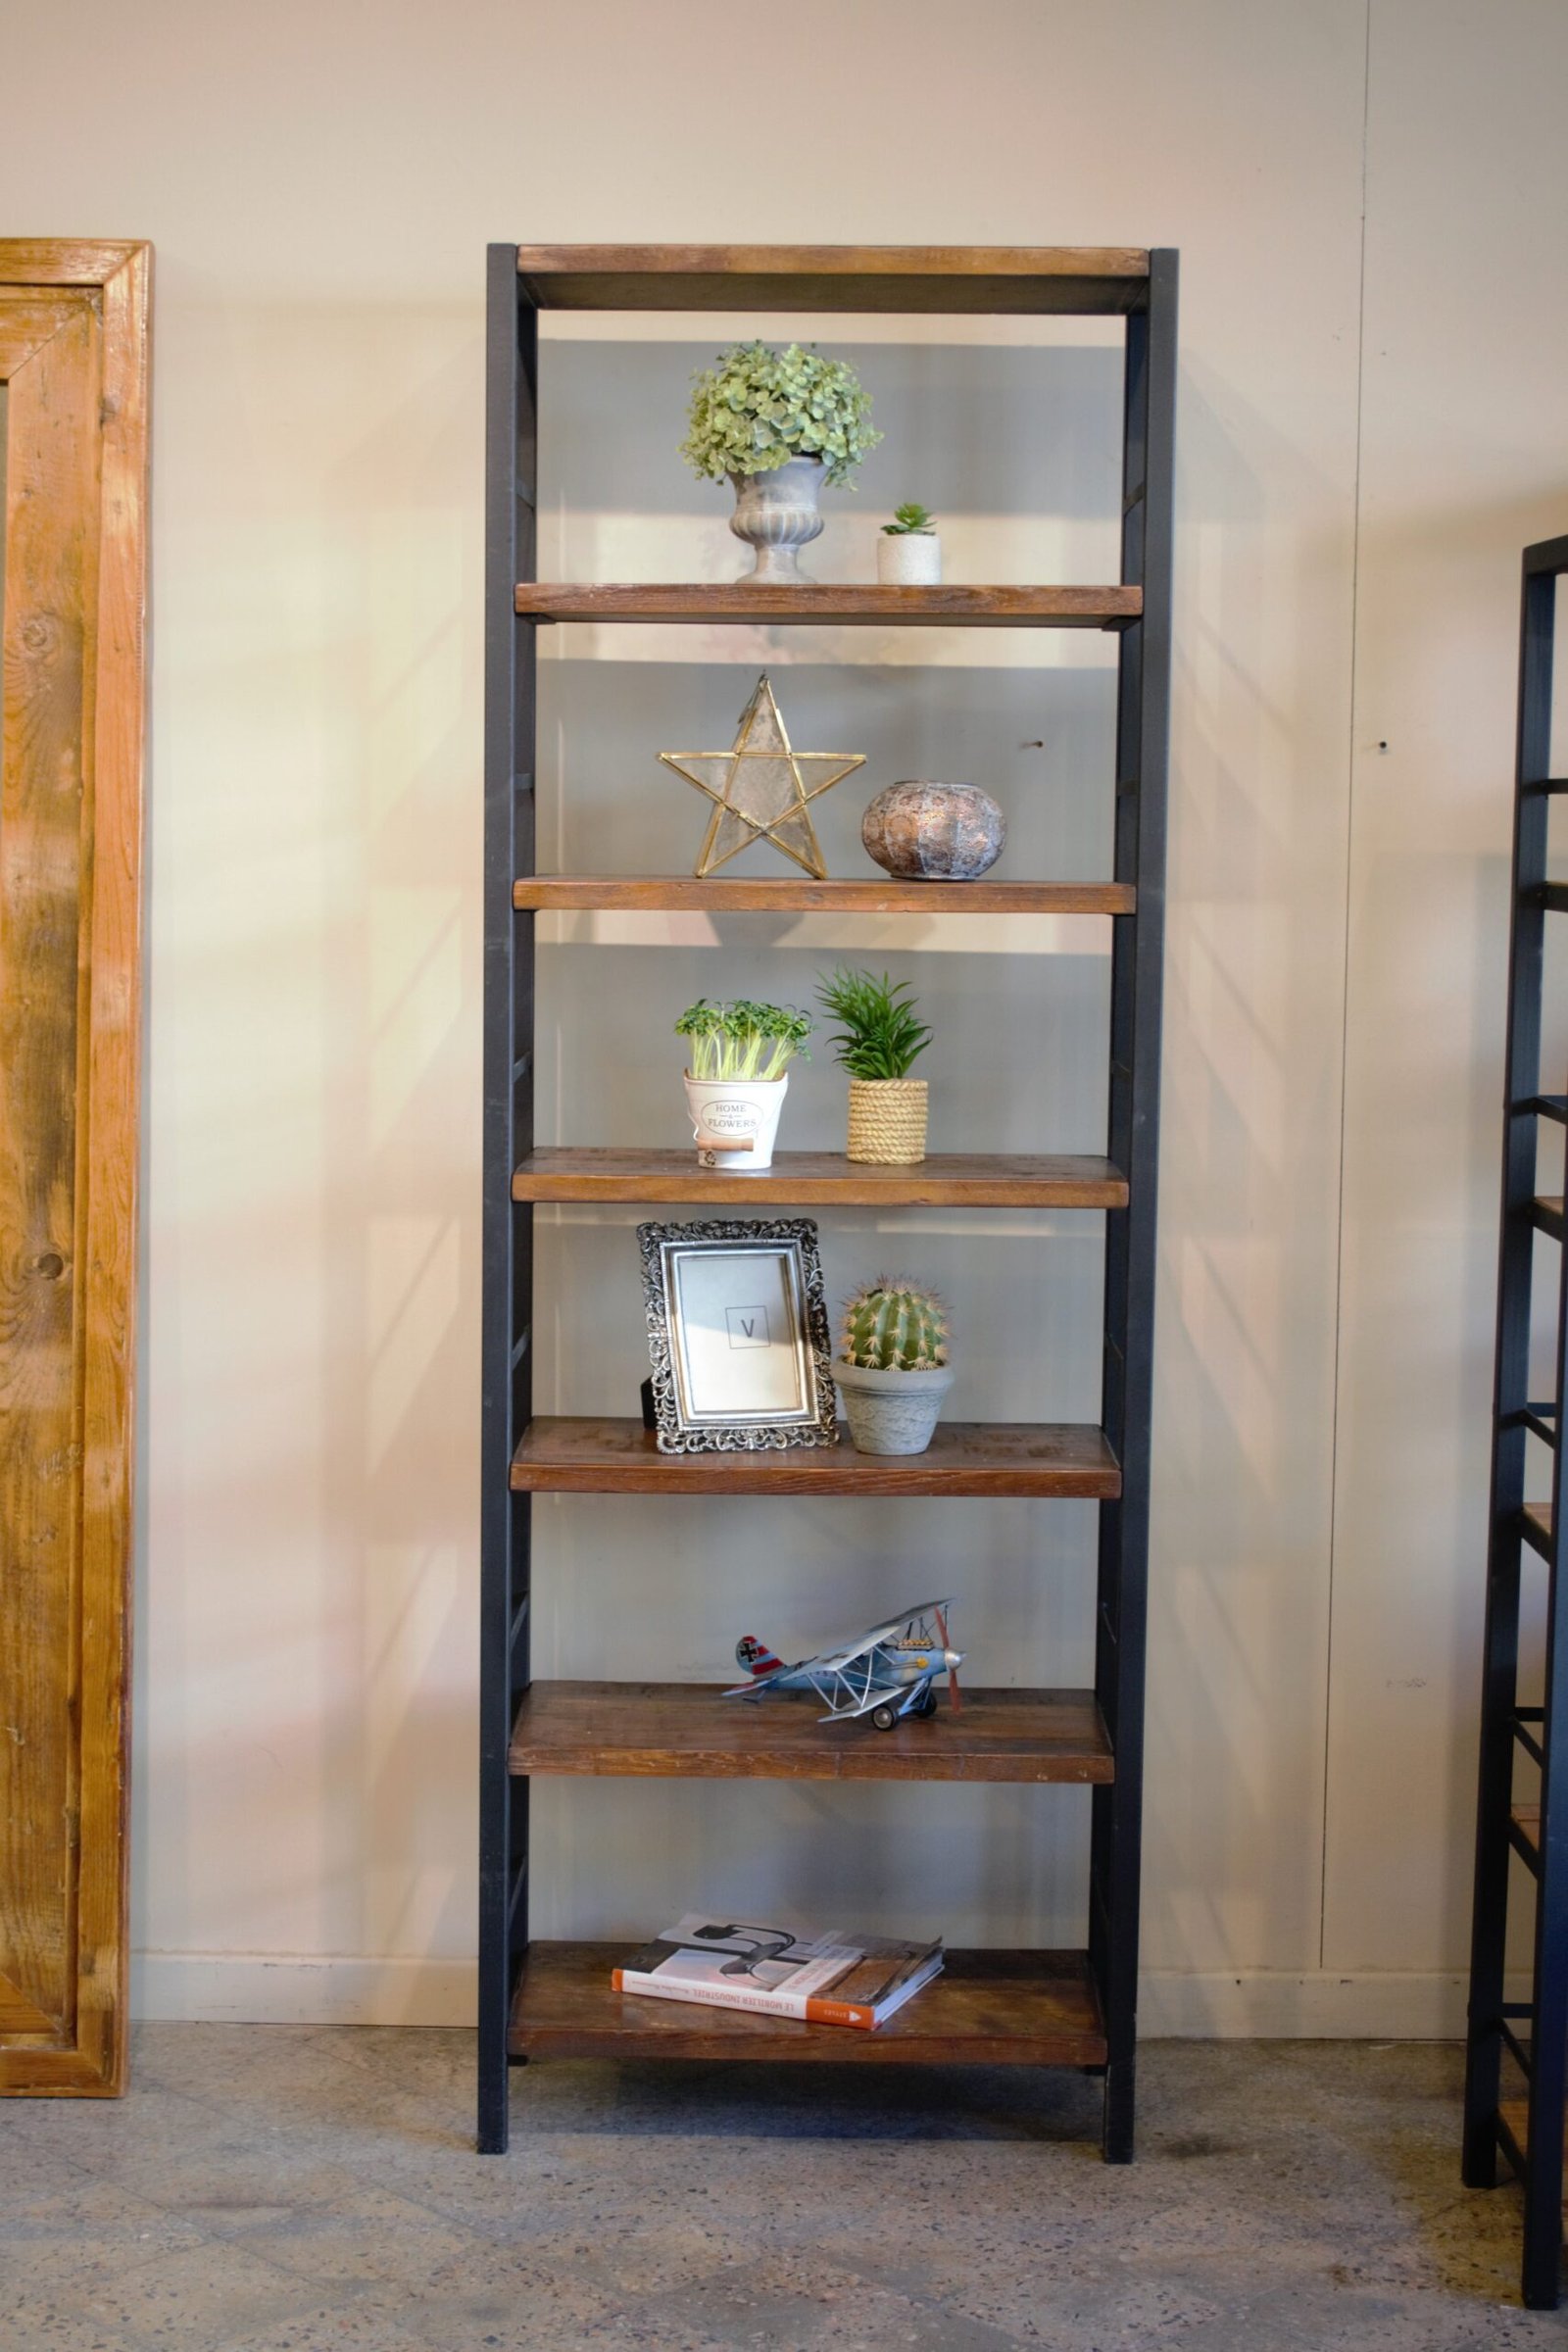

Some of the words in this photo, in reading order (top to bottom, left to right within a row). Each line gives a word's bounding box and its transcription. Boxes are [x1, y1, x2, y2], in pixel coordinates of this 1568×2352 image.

[709, 1119, 757, 1128] FLOWERS
[741, 1319, 755, 1338] V
[692, 1988, 741, 2003] INDUSTRIEL
[743, 1997, 783, 2009] MOBILIER
[784, 2003, 795, 2012] LE
